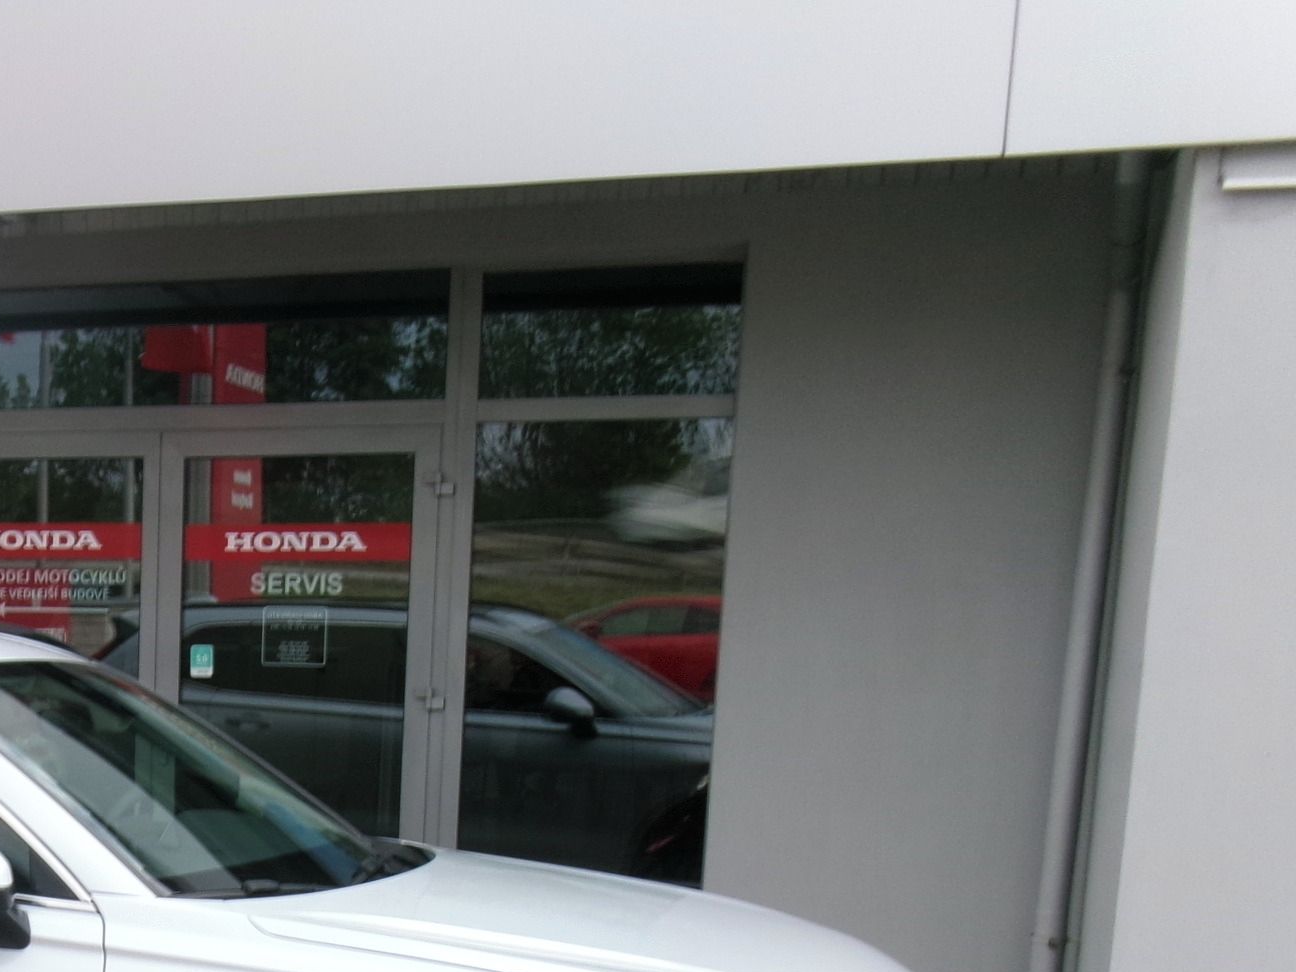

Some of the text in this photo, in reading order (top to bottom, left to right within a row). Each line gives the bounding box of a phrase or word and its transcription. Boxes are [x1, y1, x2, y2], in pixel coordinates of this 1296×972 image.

[224, 530, 367, 552] HONDA
[34, 565, 127, 584] MOTOCYKLŮ
[250, 571, 344, 596] SERVIS
